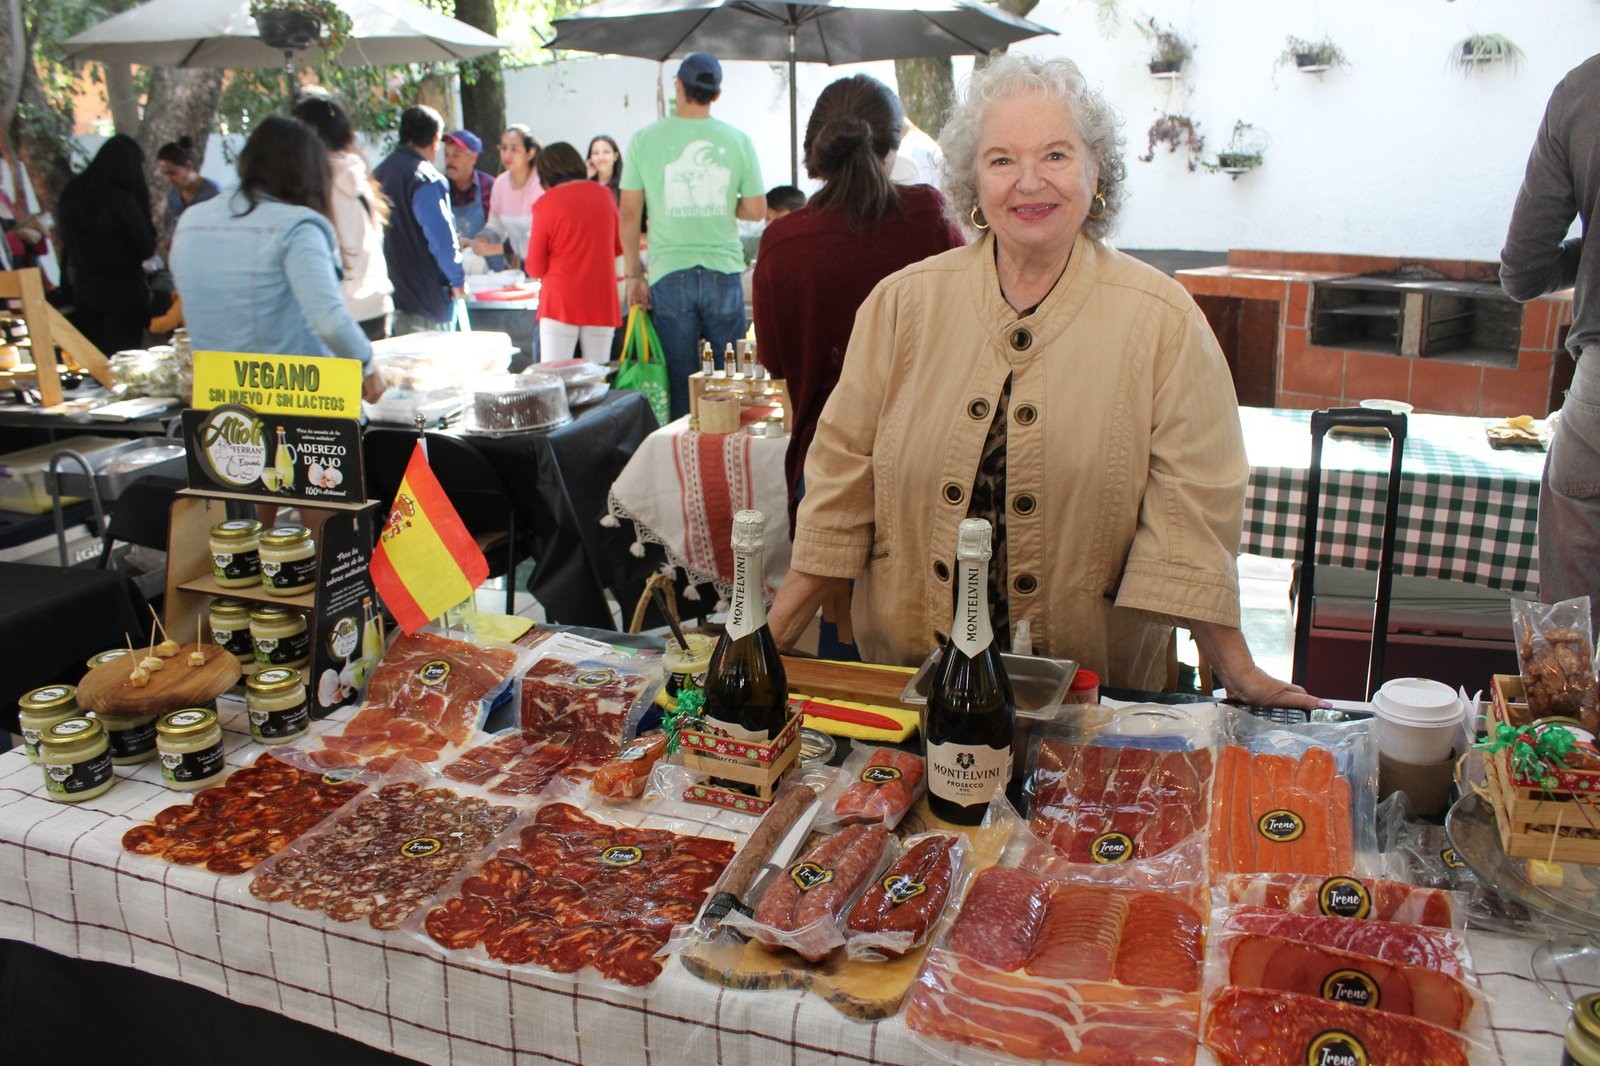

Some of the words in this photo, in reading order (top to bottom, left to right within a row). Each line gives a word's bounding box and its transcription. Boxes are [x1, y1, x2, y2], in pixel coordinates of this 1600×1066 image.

[234, 360, 320, 392] VEGANO
[209, 388, 226, 403] SIN
[229, 389, 263, 406] HUEVO
[276, 393, 293, 407] SIN
[296, 395, 345, 411] LACTEOS
[202, 416, 264, 448] Alioli
[296, 443, 347, 456] ADEREZO
[303, 455, 319, 465] DE
[320, 457, 341, 468] AJO
[733, 555, 746, 626] MONTELVINI
[966, 568, 979, 642] MONTELVINI
[934, 762, 1000, 780] MONTELVINI
[947, 780, 984, 789] PROSECCO
[1269, 819, 1296, 830] Irene
[610, 850, 635, 859] Irene
[1099, 841, 1126, 854] Irene
[1330, 890, 1361, 907] Irene
[1334, 983, 1368, 999] Irene
[1321, 1047, 1357, 1066] Irene
